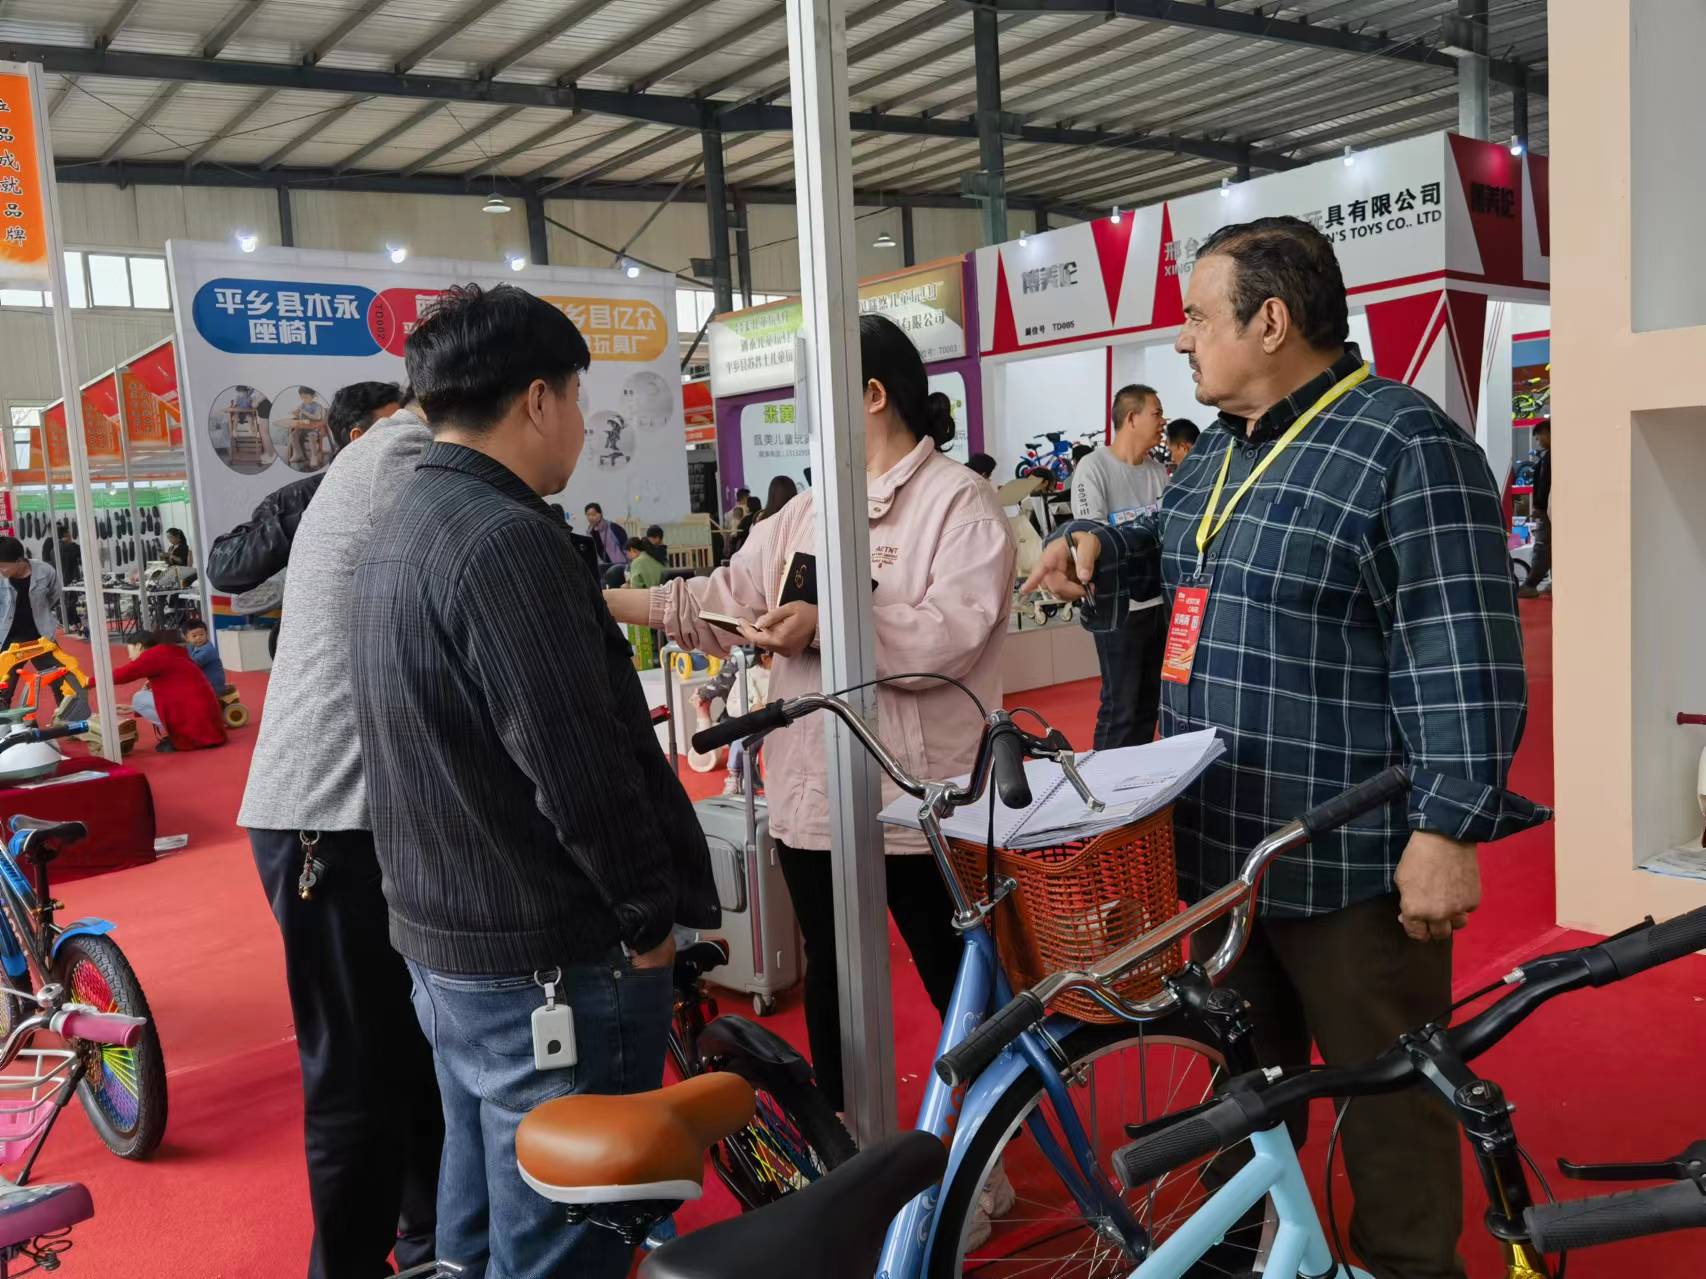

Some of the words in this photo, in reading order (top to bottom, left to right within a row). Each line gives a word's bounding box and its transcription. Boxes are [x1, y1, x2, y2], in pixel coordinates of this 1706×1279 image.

[1350, 221, 1383, 239] TOYS
[1416, 209, 1442, 225] LTD
[213, 287, 361, 320] 平乡县木永
[553, 303, 657, 330] 乡县亿众
[248, 318, 334, 346] 座椅厂
[583, 334, 649, 354] 玩具厂
